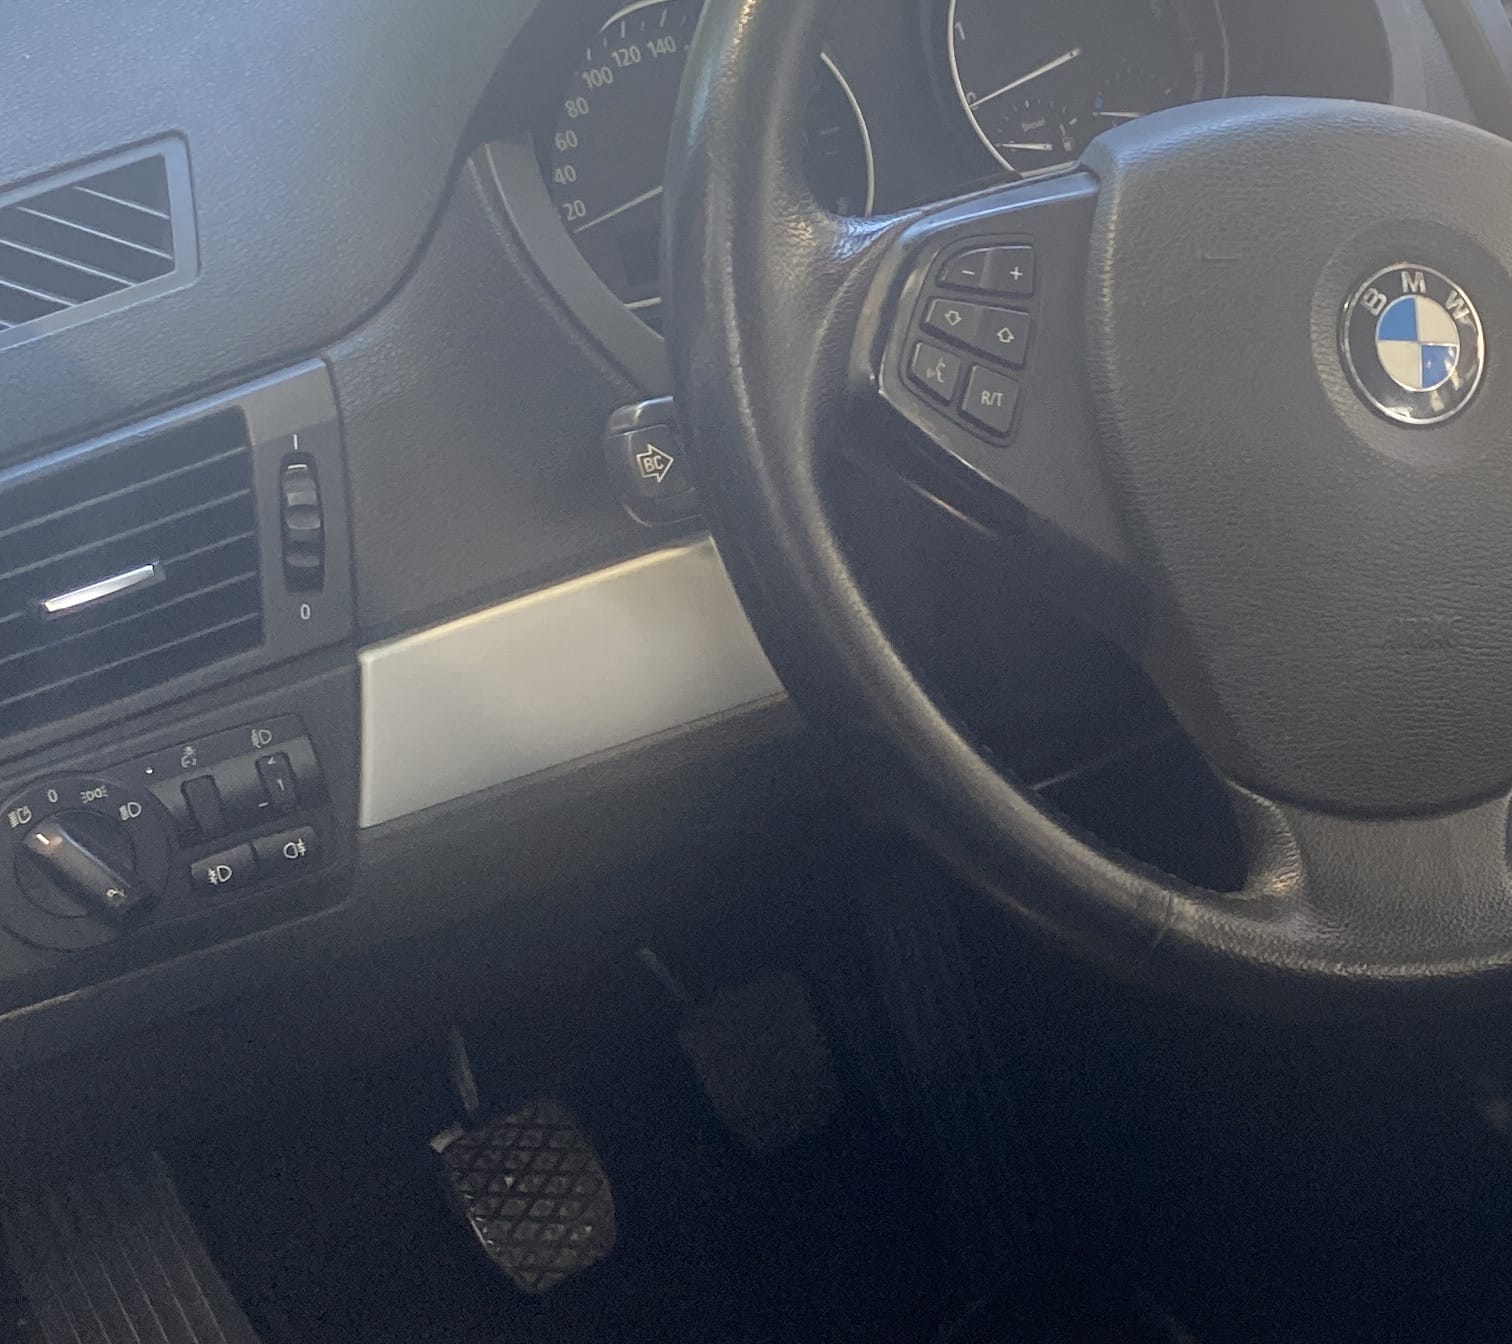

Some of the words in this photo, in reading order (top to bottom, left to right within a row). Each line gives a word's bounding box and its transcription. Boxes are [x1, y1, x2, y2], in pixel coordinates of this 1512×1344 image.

[611, 45, 641, 68] 120
[647, 36, 677, 58] 140
[582, 66, 614, 89] 100
[565, 96, 590, 119] 80
[555, 129, 578, 152] 60
[554, 164, 577, 185] 40
[562, 199, 586, 221] 20
[1361, 270, 1470, 320] BMW
[980, 389, 1004, 407] R/T
[643, 455, 665, 473] BC
